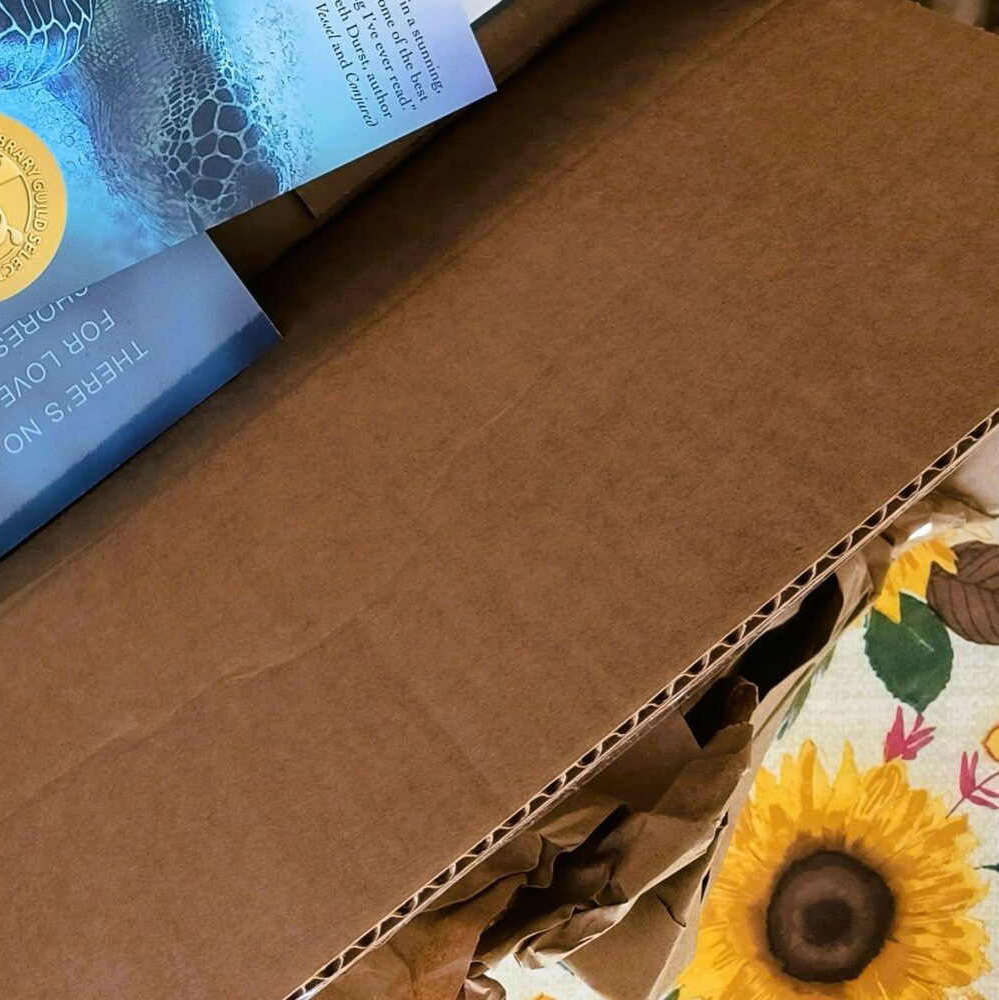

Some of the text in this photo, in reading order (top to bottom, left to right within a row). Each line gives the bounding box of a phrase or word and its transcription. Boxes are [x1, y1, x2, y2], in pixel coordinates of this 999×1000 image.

[362, 12, 379, 39] I've
[375, 42, 394, 71] ever
[391, 31, 408, 46] of
[399, 0, 411, 15] in
[412, 29, 443, 94] stunning,
[399, 48, 413, 71] the
[315, 3, 342, 40] Vessel
[332, 43, 353, 69] and
[345, 72, 379, 127] Conjured
[346, 23, 369, 70] Durst,
[366, 73, 393, 118] author
[410, 71, 428, 102] best
[31, 180, 49, 232] GUILD
[62, 308, 116, 355] FOR
[44, 340, 149, 423] THERE'S
[4, 418, 42, 453] NO
